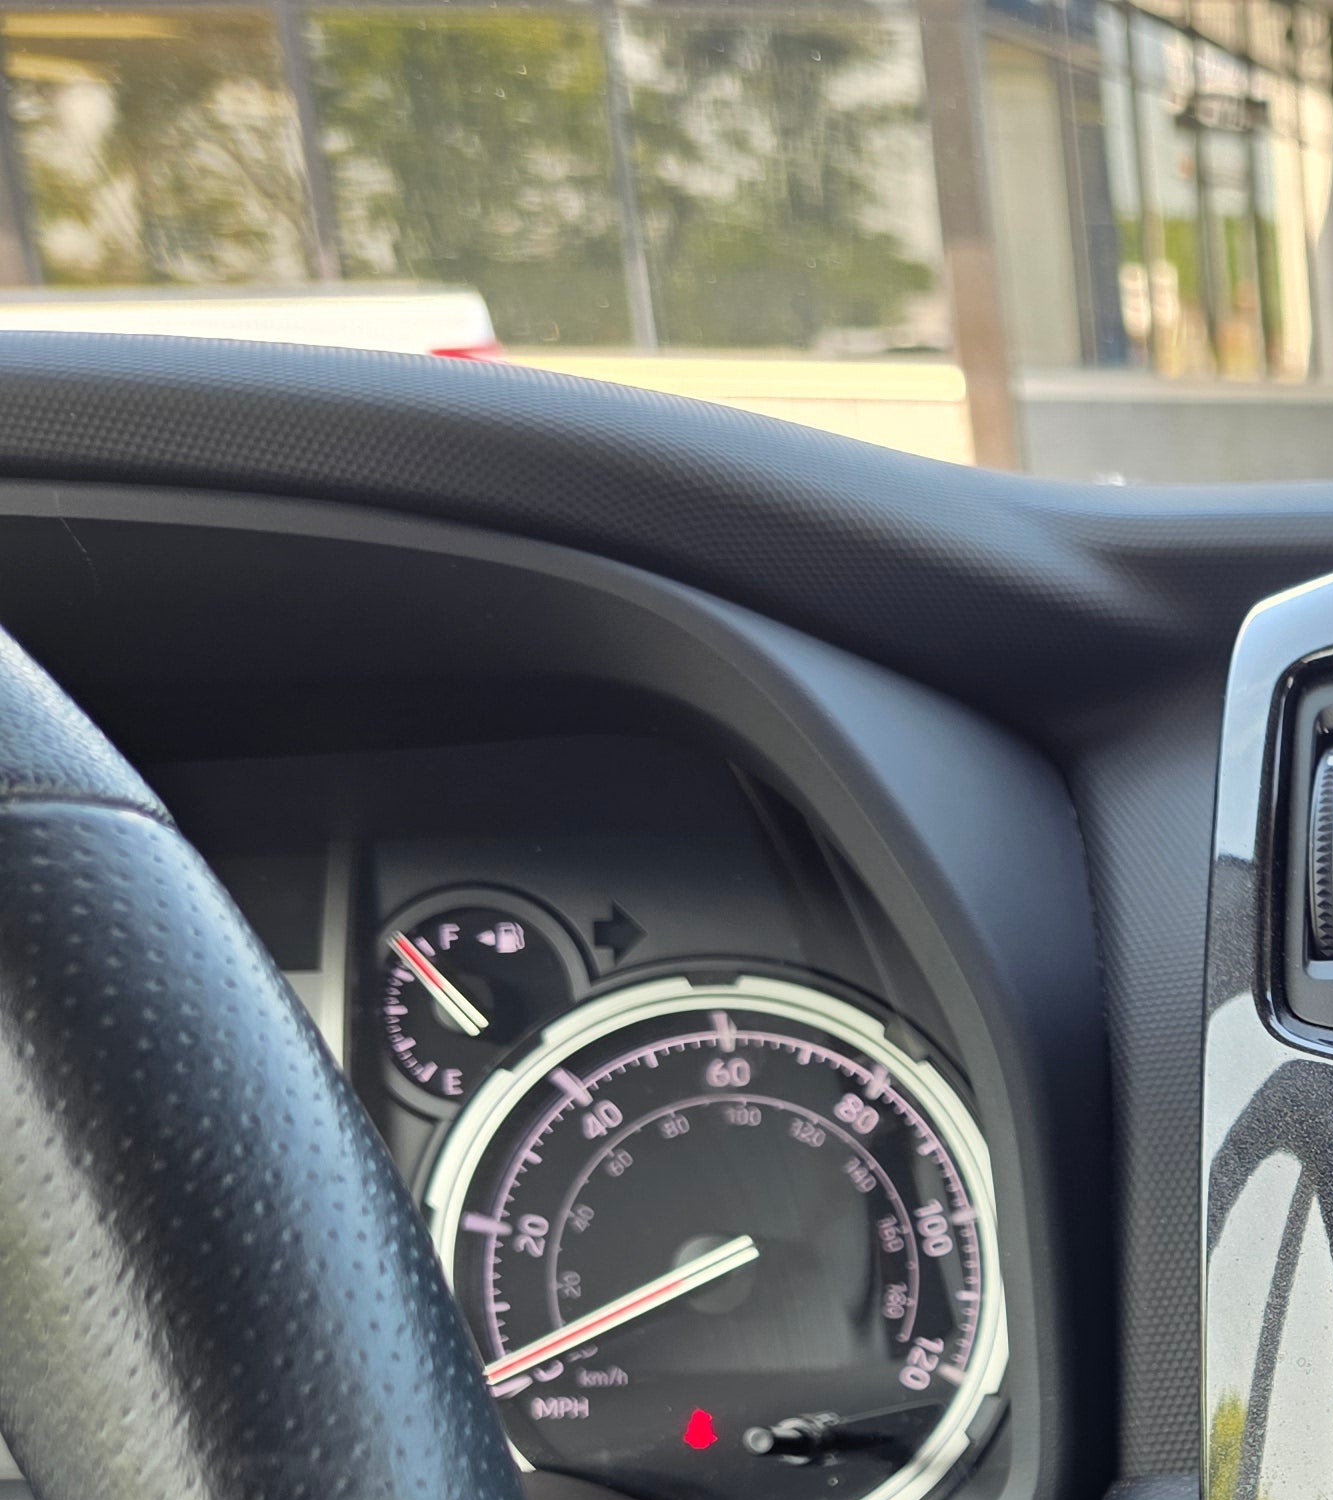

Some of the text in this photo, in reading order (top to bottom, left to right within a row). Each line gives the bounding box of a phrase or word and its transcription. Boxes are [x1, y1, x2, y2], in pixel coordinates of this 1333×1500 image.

[437, 923, 461, 950] F
[441, 1068, 464, 1096] E
[706, 1057, 751, 1087] 60
[582, 1099, 624, 1140] 40
[834, 1093, 880, 1135] 80
[512, 1213, 550, 1258] 20
[912, 1199, 953, 1258] 100
[576, 1364, 629, 1389] km/h
[899, 1336, 945, 1391] 120
[530, 1395, 590, 1421] MPH
